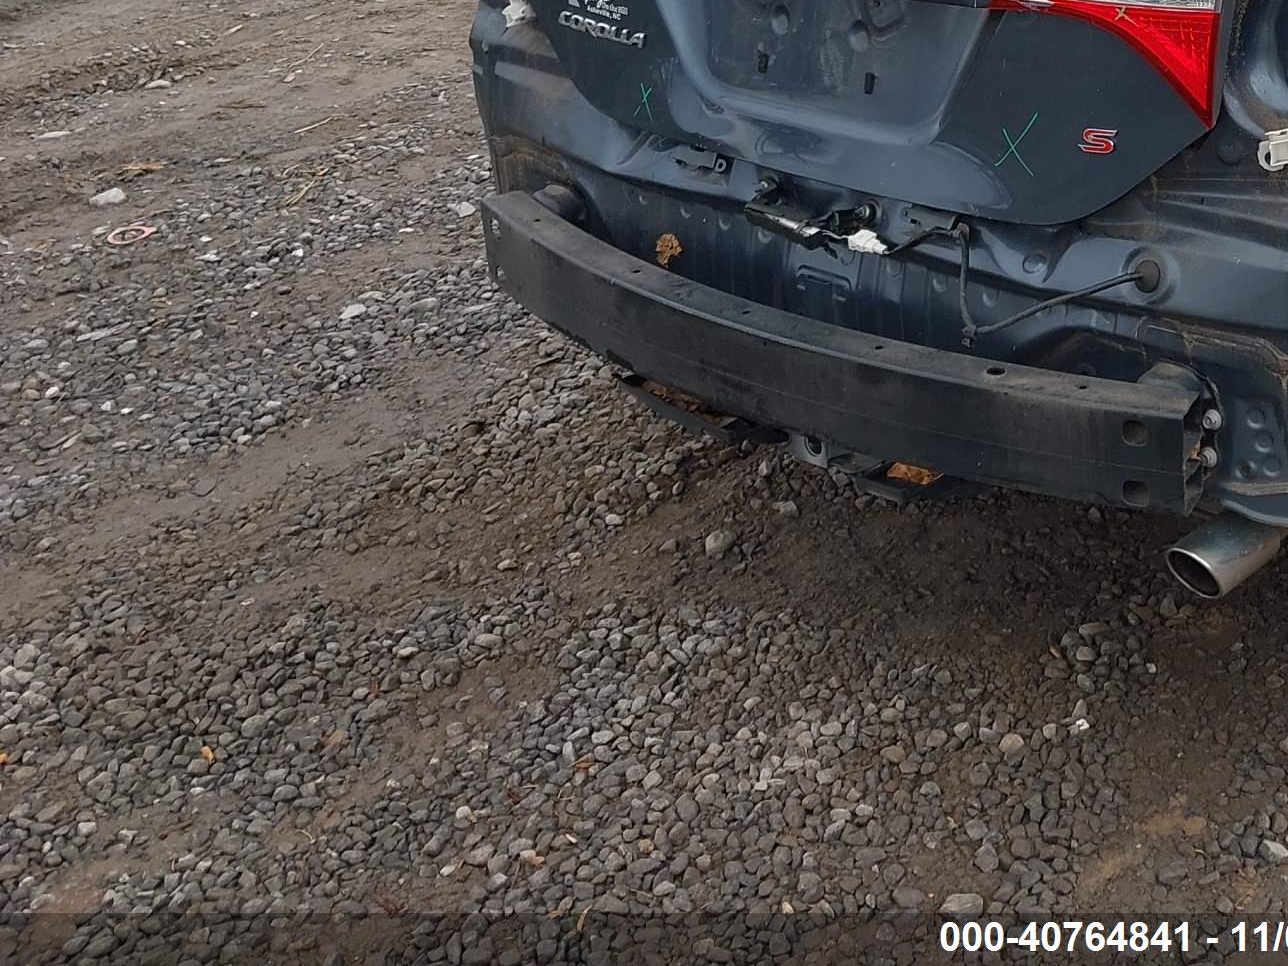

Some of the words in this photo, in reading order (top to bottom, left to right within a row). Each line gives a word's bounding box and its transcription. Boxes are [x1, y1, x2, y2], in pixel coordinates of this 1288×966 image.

[558, 11, 646, 48] COROLLA
[612, 12, 622, 21] NC
[1077, 128, 1118, 154] S
